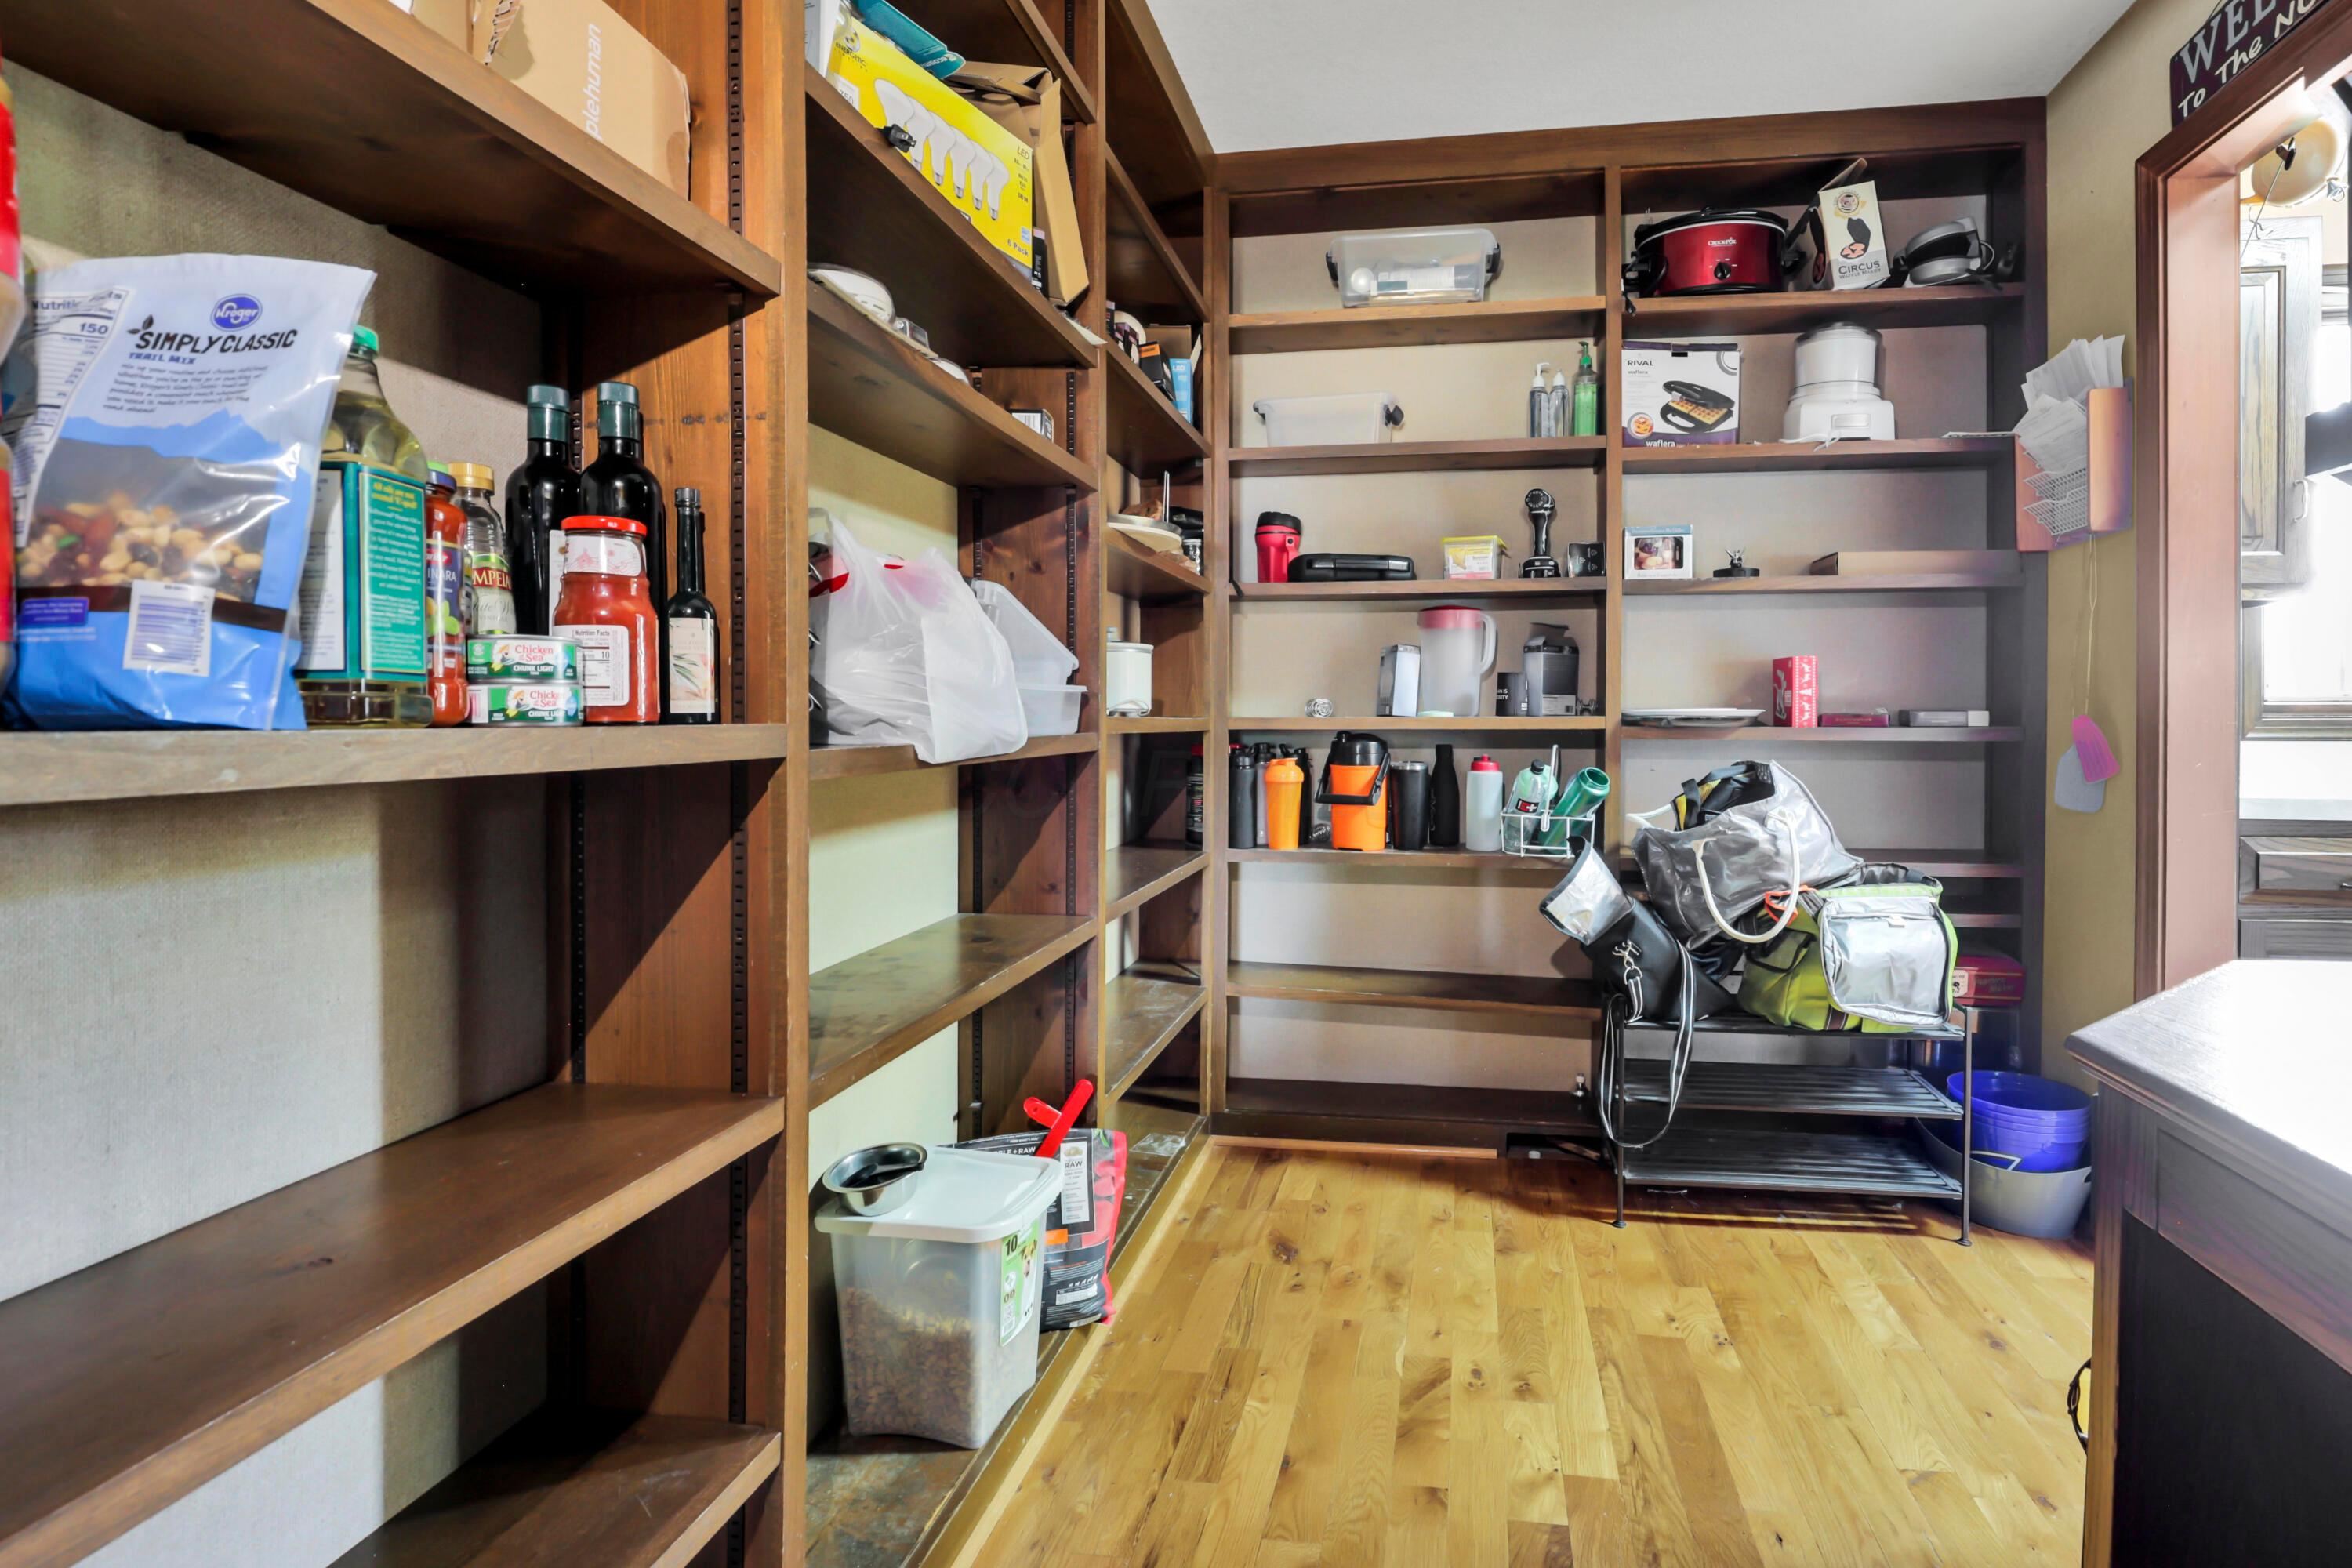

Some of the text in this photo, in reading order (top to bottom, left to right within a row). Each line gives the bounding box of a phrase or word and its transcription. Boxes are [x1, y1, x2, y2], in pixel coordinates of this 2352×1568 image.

[2179, 0, 2276, 84] WEL
[581, 23, 602, 141] plehuman
[1017, 145, 1029, 160] LED
[1013, 241, 1029, 257] Pack
[1838, 260, 1881, 275] CIRCUS
[216, 303, 259, 324] Kroger
[80, 322, 109, 335] 150
[135, 329, 298, 354] SIMPLY CLASSIC
[128, 352, 196, 365] TRAIL MIX
[472, 569, 512, 590] MPEIA
[514, 644, 554, 655] Chicken
[601, 651, 610, 659] 10
[525, 653, 544, 662] Sea
[1018, 1146, 1037, 1155] RAW
[1065, 1160, 1083, 1169] RAW
[1005, 1234, 1018, 1256] 10
